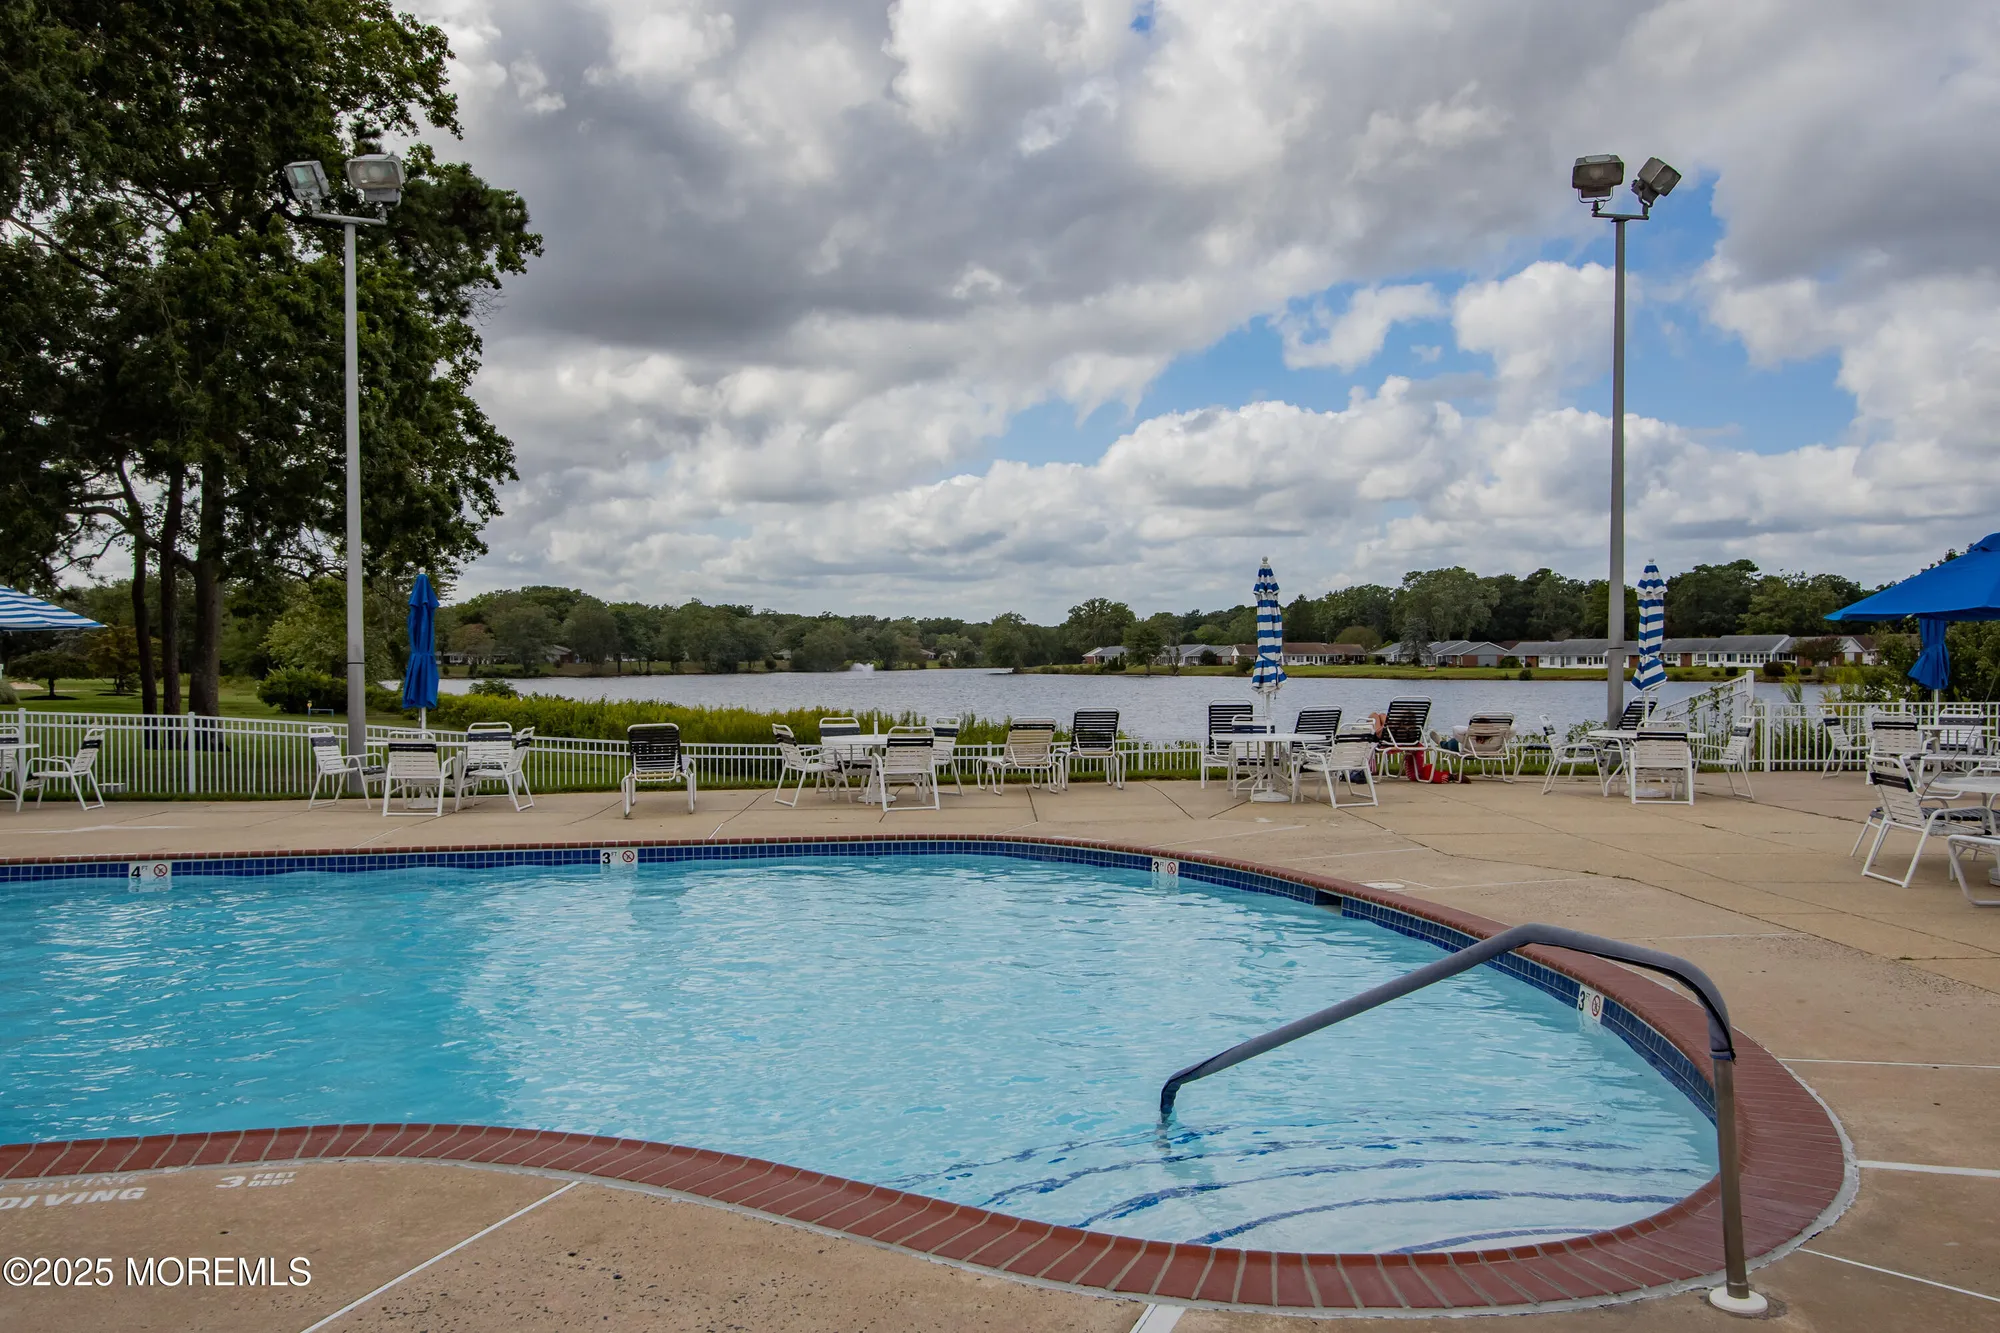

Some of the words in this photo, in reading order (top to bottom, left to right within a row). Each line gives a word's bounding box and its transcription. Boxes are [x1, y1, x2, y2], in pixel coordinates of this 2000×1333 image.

[602, 852, 611, 864] 3
[131, 865, 141, 878] 4
[1153, 861, 1160, 873] 3
[1578, 990, 1586, 1011] 3
[253, 1171, 298, 1180] FEET
[215, 1175, 246, 1189] 3
[247, 1178, 295, 1188] DEEP
